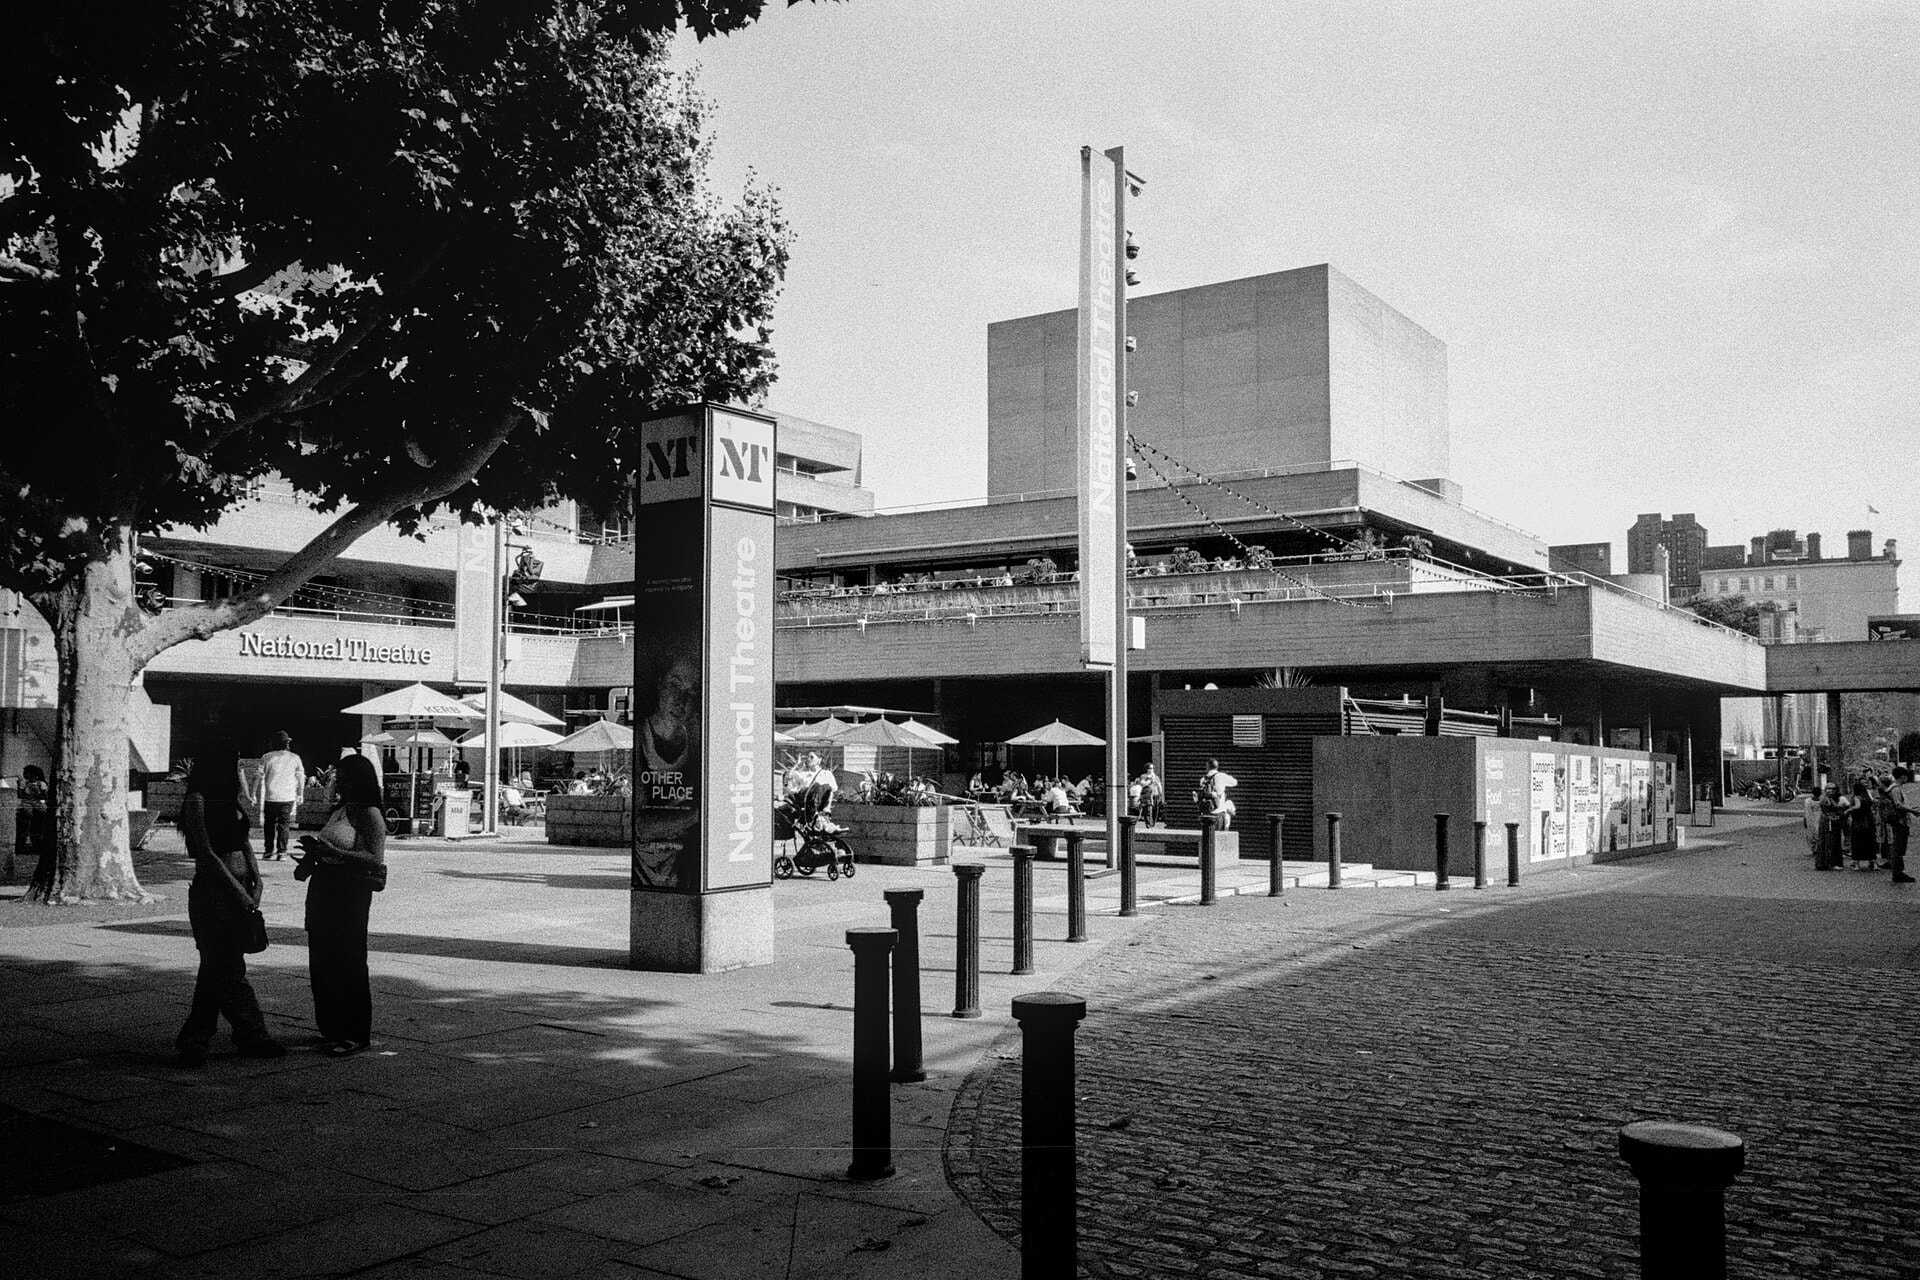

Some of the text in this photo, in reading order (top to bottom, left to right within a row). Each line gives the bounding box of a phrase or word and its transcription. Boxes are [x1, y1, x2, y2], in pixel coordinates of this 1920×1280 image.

[1094, 178, 1114, 514] National Theatre
[646, 436, 697, 482] NT
[720, 437, 768, 483] NT
[240, 631, 433, 665] National Theatre
[729, 536, 756, 863] National Theatre
[424, 705, 462, 714] KERB
[1532, 759, 1555, 773] London's
[641, 771, 683, 785] OTHER
[1533, 777, 1544, 791] Best
[652, 786, 694, 800] PLACE
[1486, 788, 1502, 804] Food
